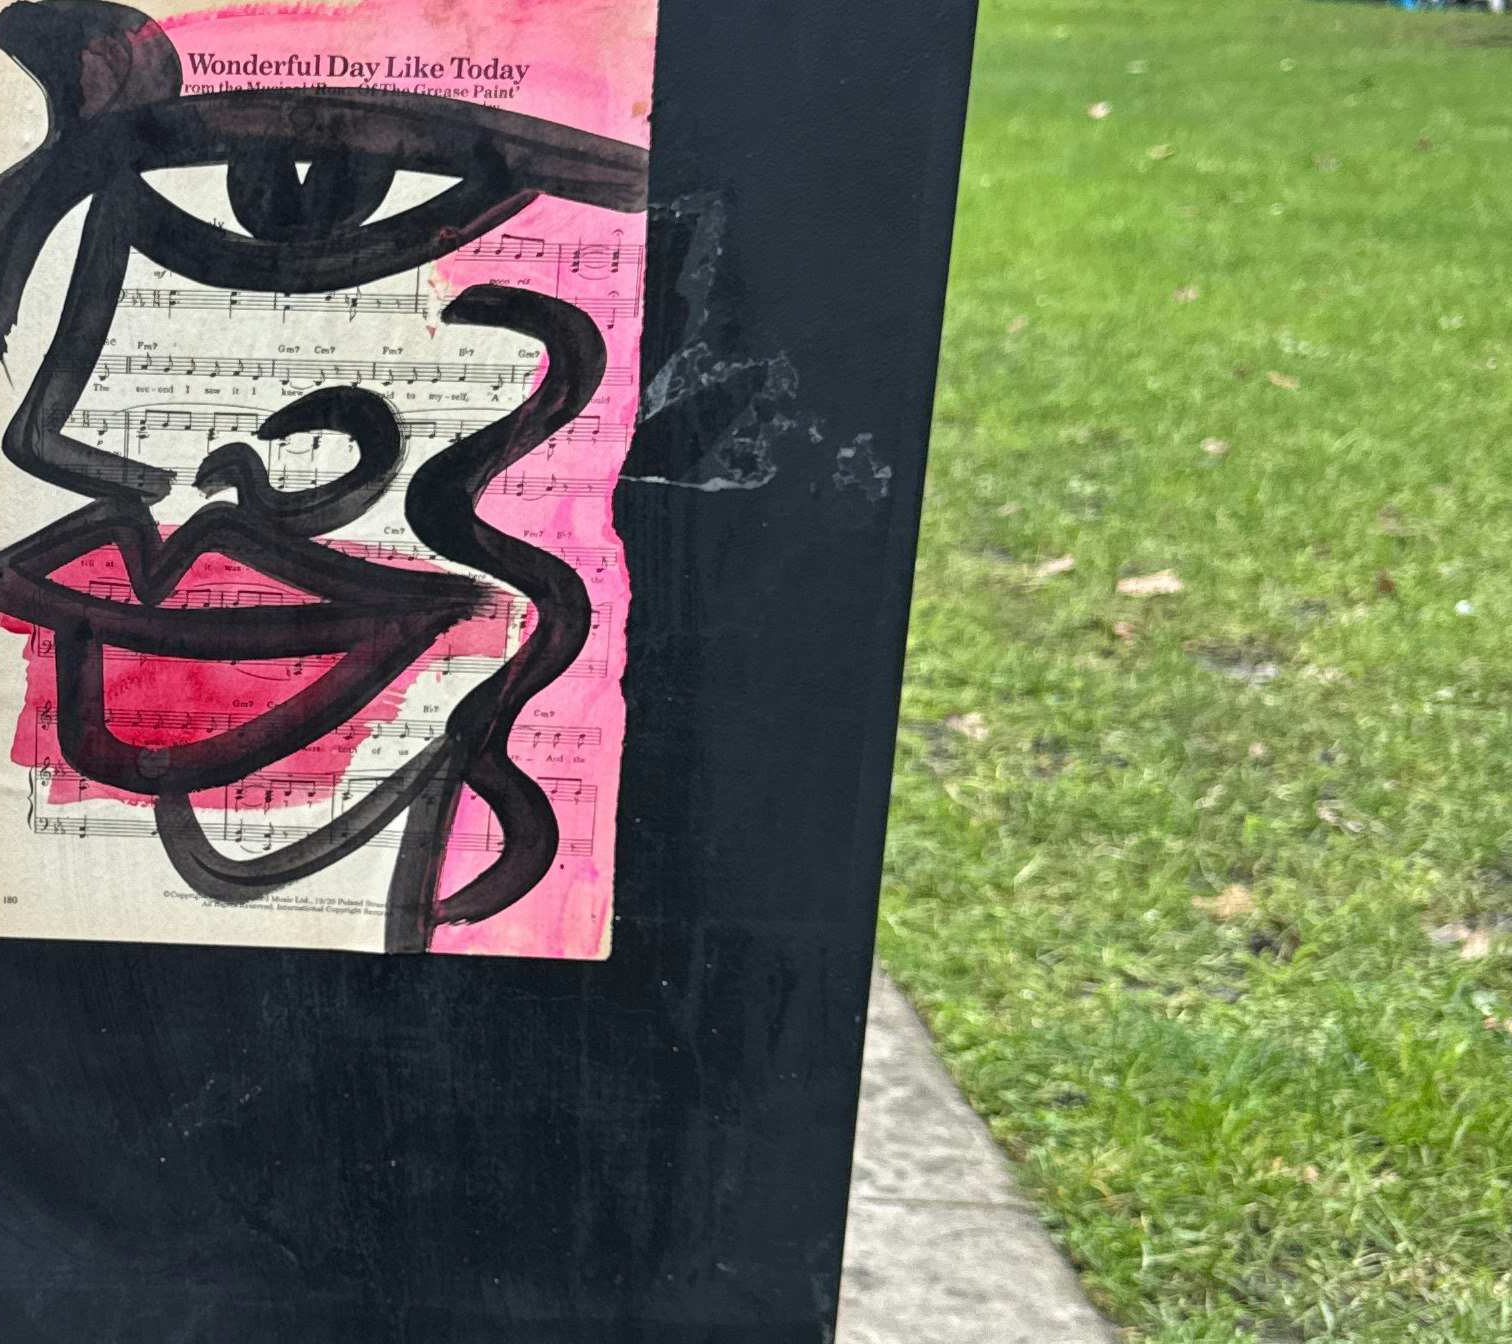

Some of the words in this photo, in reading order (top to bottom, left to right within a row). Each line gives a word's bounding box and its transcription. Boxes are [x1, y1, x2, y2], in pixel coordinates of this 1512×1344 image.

[188, 52, 322, 76] Wonderful
[326, 54, 381, 84] Day
[384, 56, 445, 80] Like
[449, 56, 531, 86] Today
[414, 84, 470, 98] Grease
[93, 383, 110, 393] The
[204, 387, 221, 395] saw
[232, 386, 239, 395] it
[406, 392, 416, 401] to
[545, 754, 565, 764] And
[3, 895, 18, 905] 180
